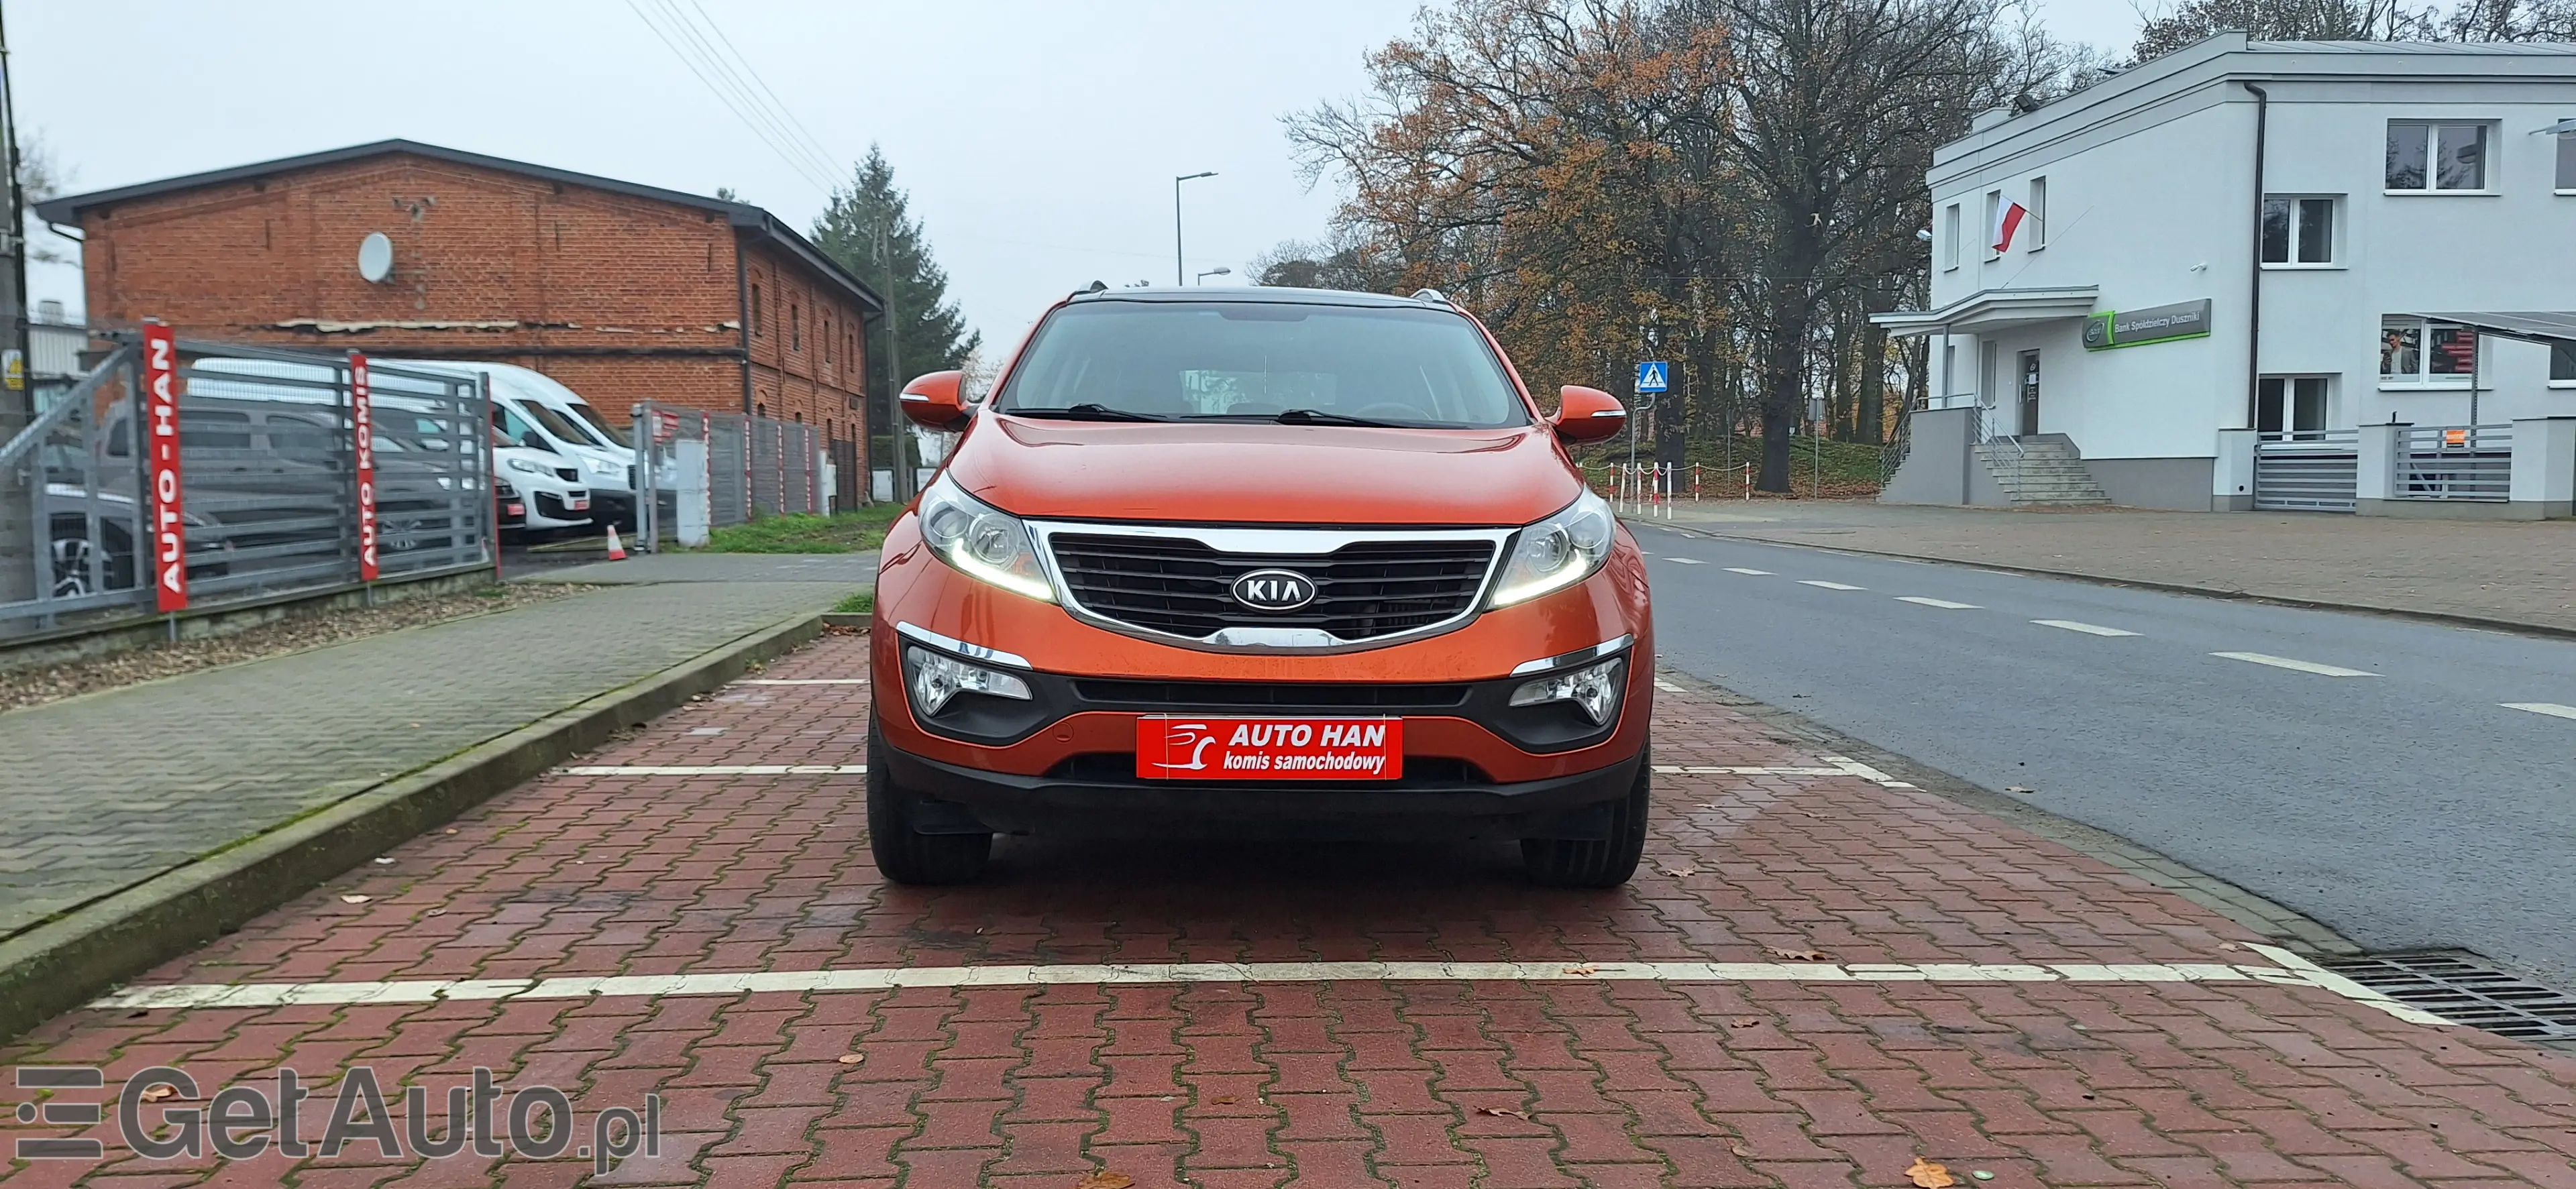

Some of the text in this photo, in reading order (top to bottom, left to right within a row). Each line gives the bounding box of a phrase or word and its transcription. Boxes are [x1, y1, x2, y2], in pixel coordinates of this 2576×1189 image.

[2114, 323, 2130, 333] Bank
[2171, 311, 2200, 325] Duszniki
[150, 339, 174, 437] HAN
[354, 365, 376, 567] AUTO KOMIS
[158, 469, 182, 593] AUTO
[1246, 579, 1301, 602] KIA
[1228, 724, 1385, 747] AUTO HAN
[1223, 751, 1385, 775] komis samochodowy
